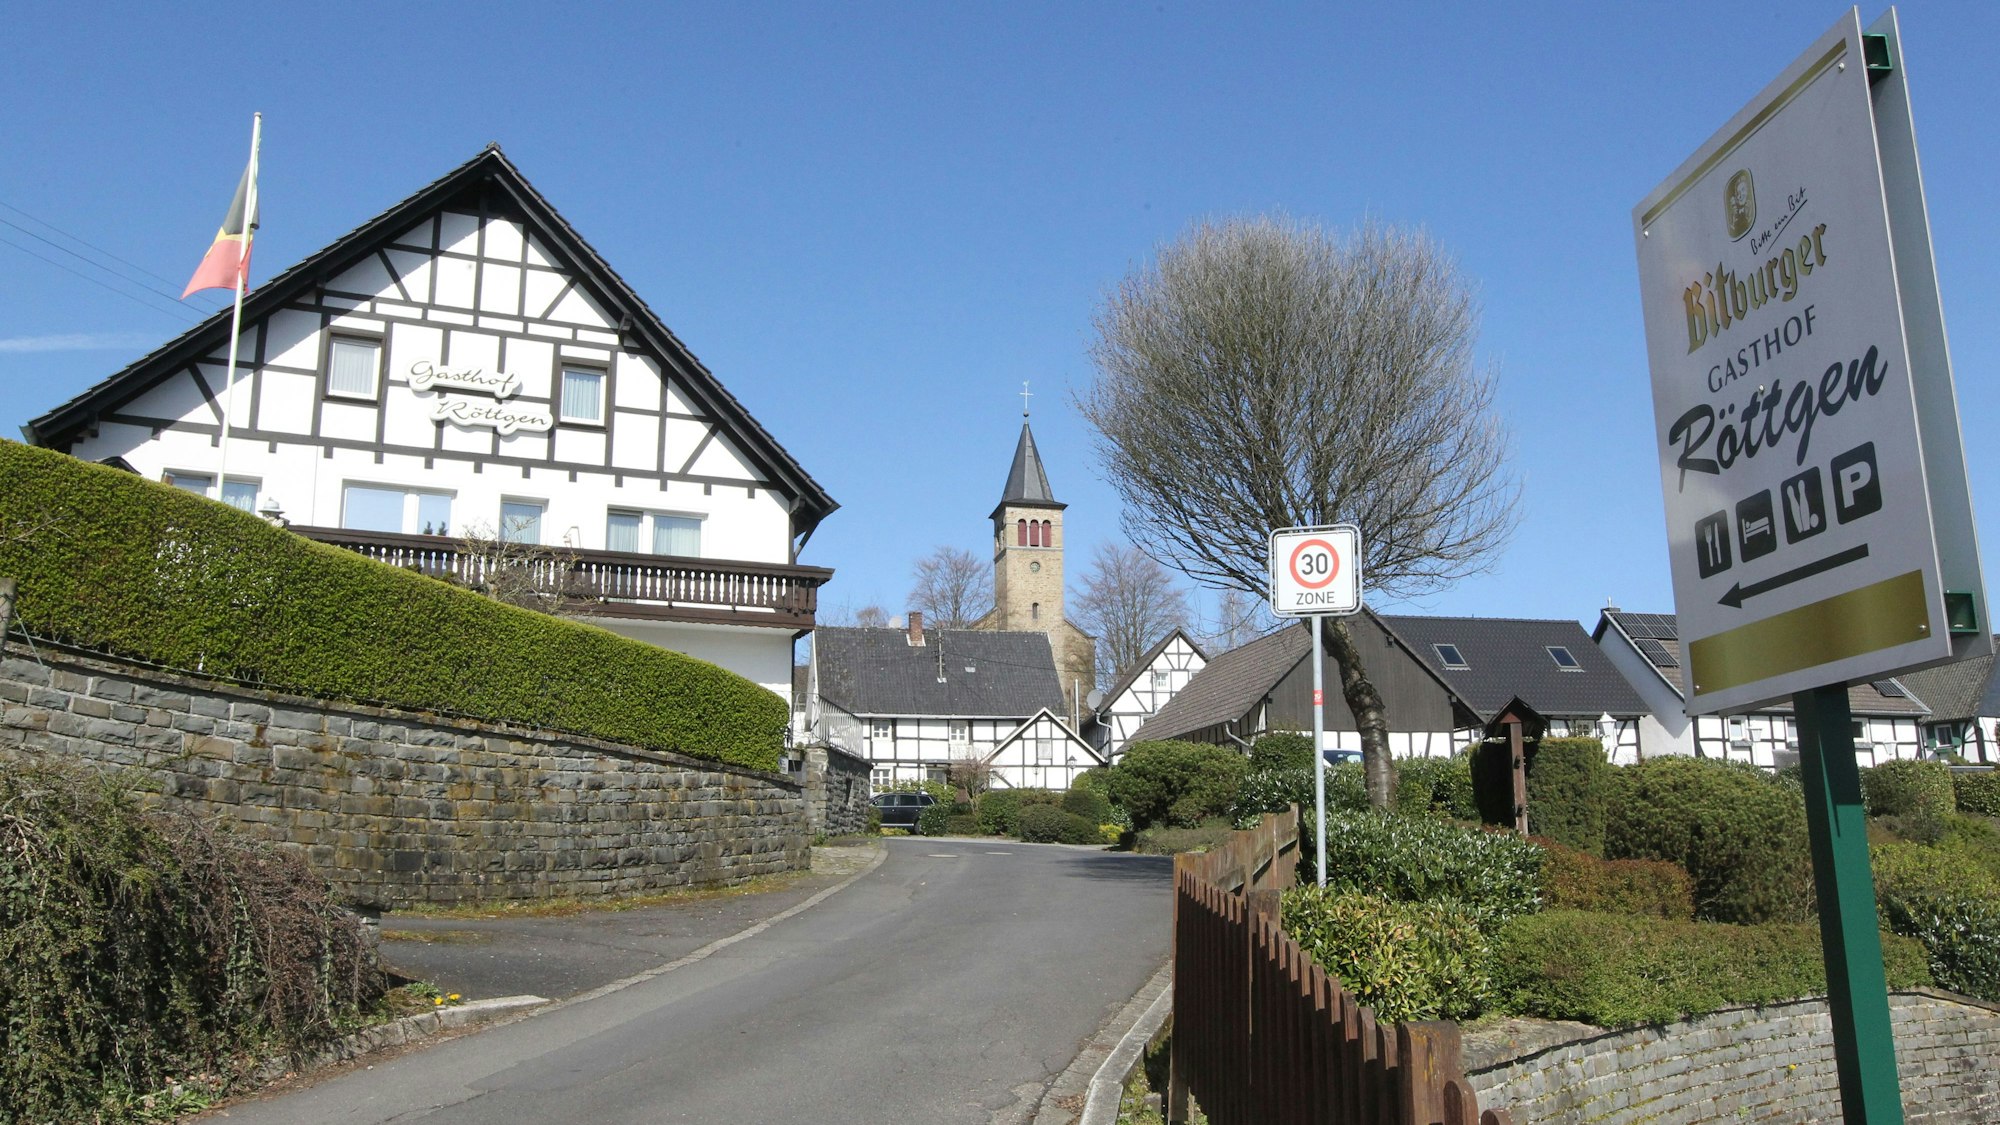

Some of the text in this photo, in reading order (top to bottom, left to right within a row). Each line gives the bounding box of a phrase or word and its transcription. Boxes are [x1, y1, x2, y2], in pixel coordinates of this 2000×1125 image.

[1750, 186, 1806, 255] Bitte ein Bit
[1683, 223, 1827, 355] Bitburger
[1707, 304, 1817, 393] GASTHOF
[410, 360, 515, 393] Gasthof
[436, 401, 548, 429] Röttgen
[1668, 344, 1889, 493] Röttgen
[1839, 460, 1873, 508] P
[1301, 552, 1329, 576] 30
[1296, 591, 1335, 606] ZONE
